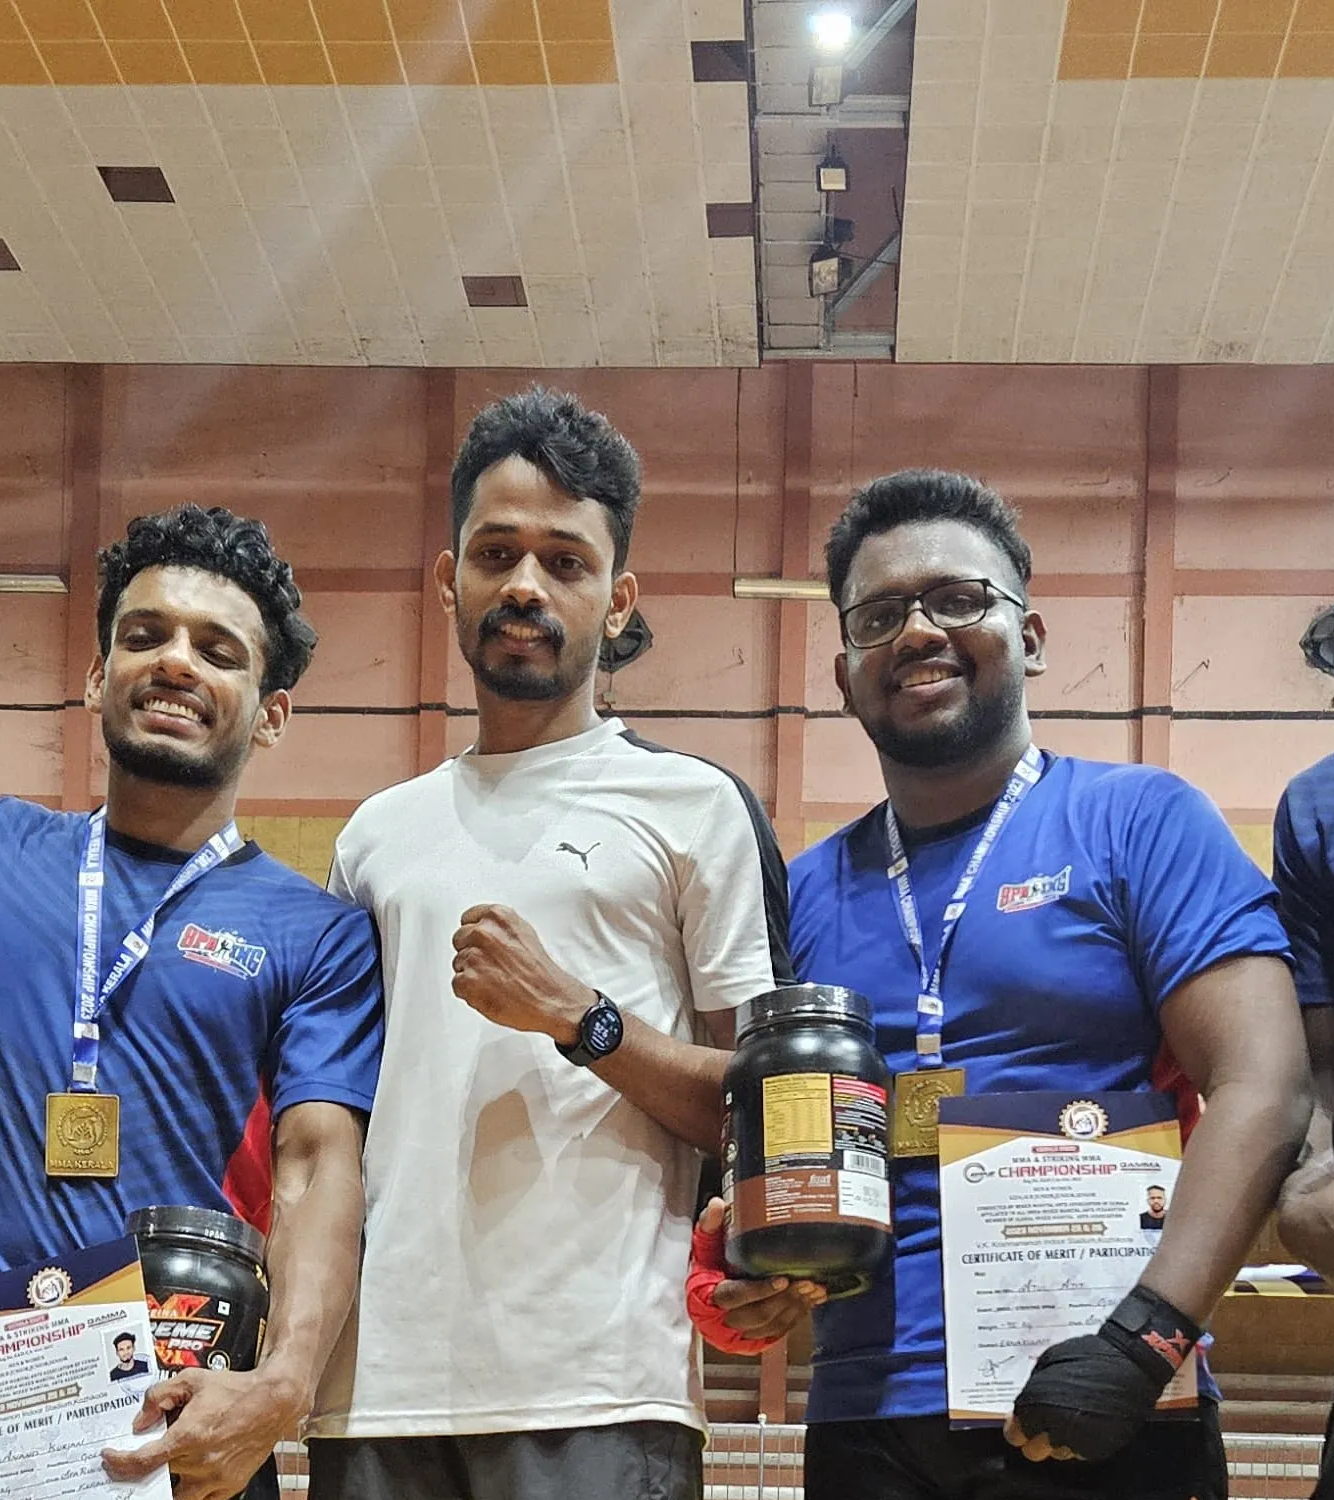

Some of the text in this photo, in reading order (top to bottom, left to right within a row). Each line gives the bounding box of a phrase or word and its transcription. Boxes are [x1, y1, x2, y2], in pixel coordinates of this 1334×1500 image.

[81, 914, 100, 994] CHAMPIONSHIP
[102, 952, 134, 995] KERALA
[80, 993, 97, 1020] 2023
[997, 1160, 1117, 1180] CHAMPIONSHIP
[1011, 1152, 1102, 1165] MMA & STRIKING MMA
[961, 1249, 1025, 1266] CERTIFICATE
[1026, 1248, 1041, 1262] OF
[1044, 1246, 1077, 1261] MERIT
[1088, 1243, 1157, 1260] PARTICIPATI
[6, 1332, 12, 1340] &
[13, 1322, 49, 1338] STRIKING
[50, 1317, 69, 1328] MMA
[168, 1338, 205, 1351] PRO
[6, 1420, 22, 1435] OF
[23, 1412, 53, 1431] MERIT
[65, 1392, 140, 1421] PARTICIPATION
